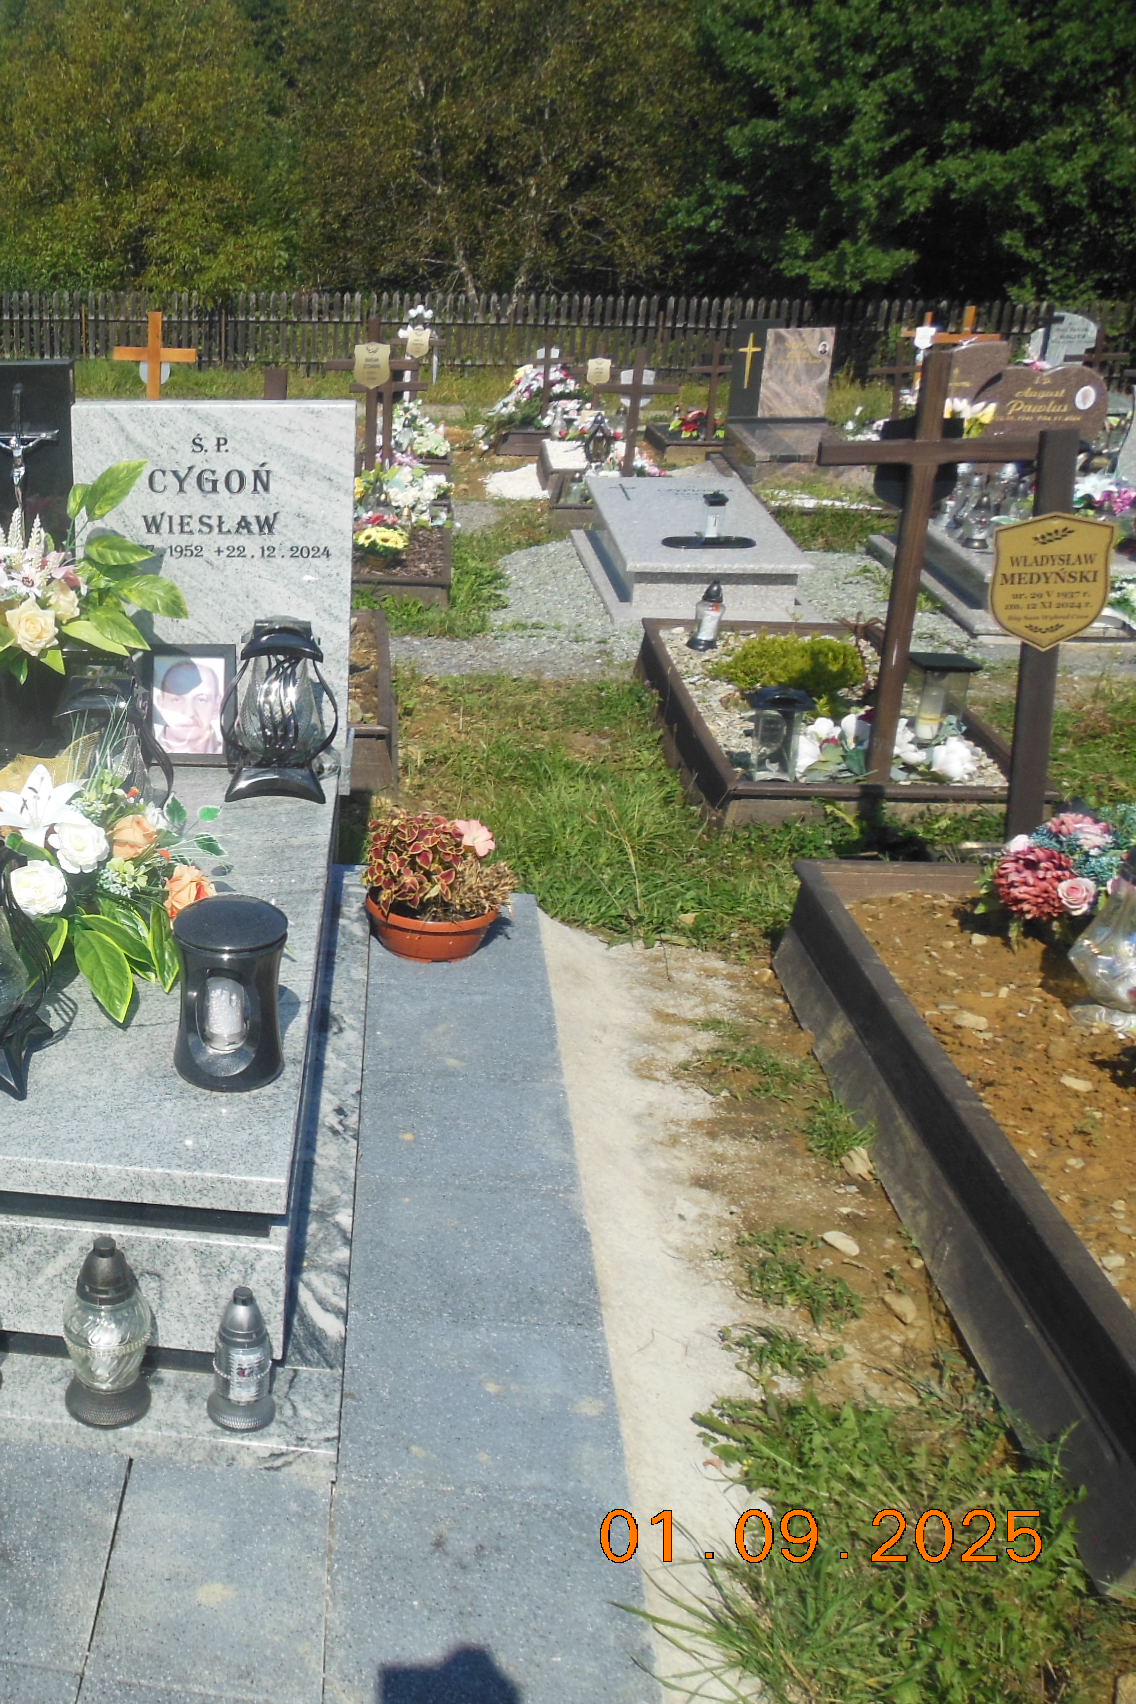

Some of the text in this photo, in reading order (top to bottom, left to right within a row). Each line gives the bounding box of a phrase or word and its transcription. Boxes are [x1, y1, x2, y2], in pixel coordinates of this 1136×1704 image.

[148, 462, 272, 494] CYGOŃ
[142, 511, 280, 535] WIESŁAW
[1009, 553, 1098, 567] WŁADYSŁAW
[999, 567, 1099, 586] MEDYŃSKI
